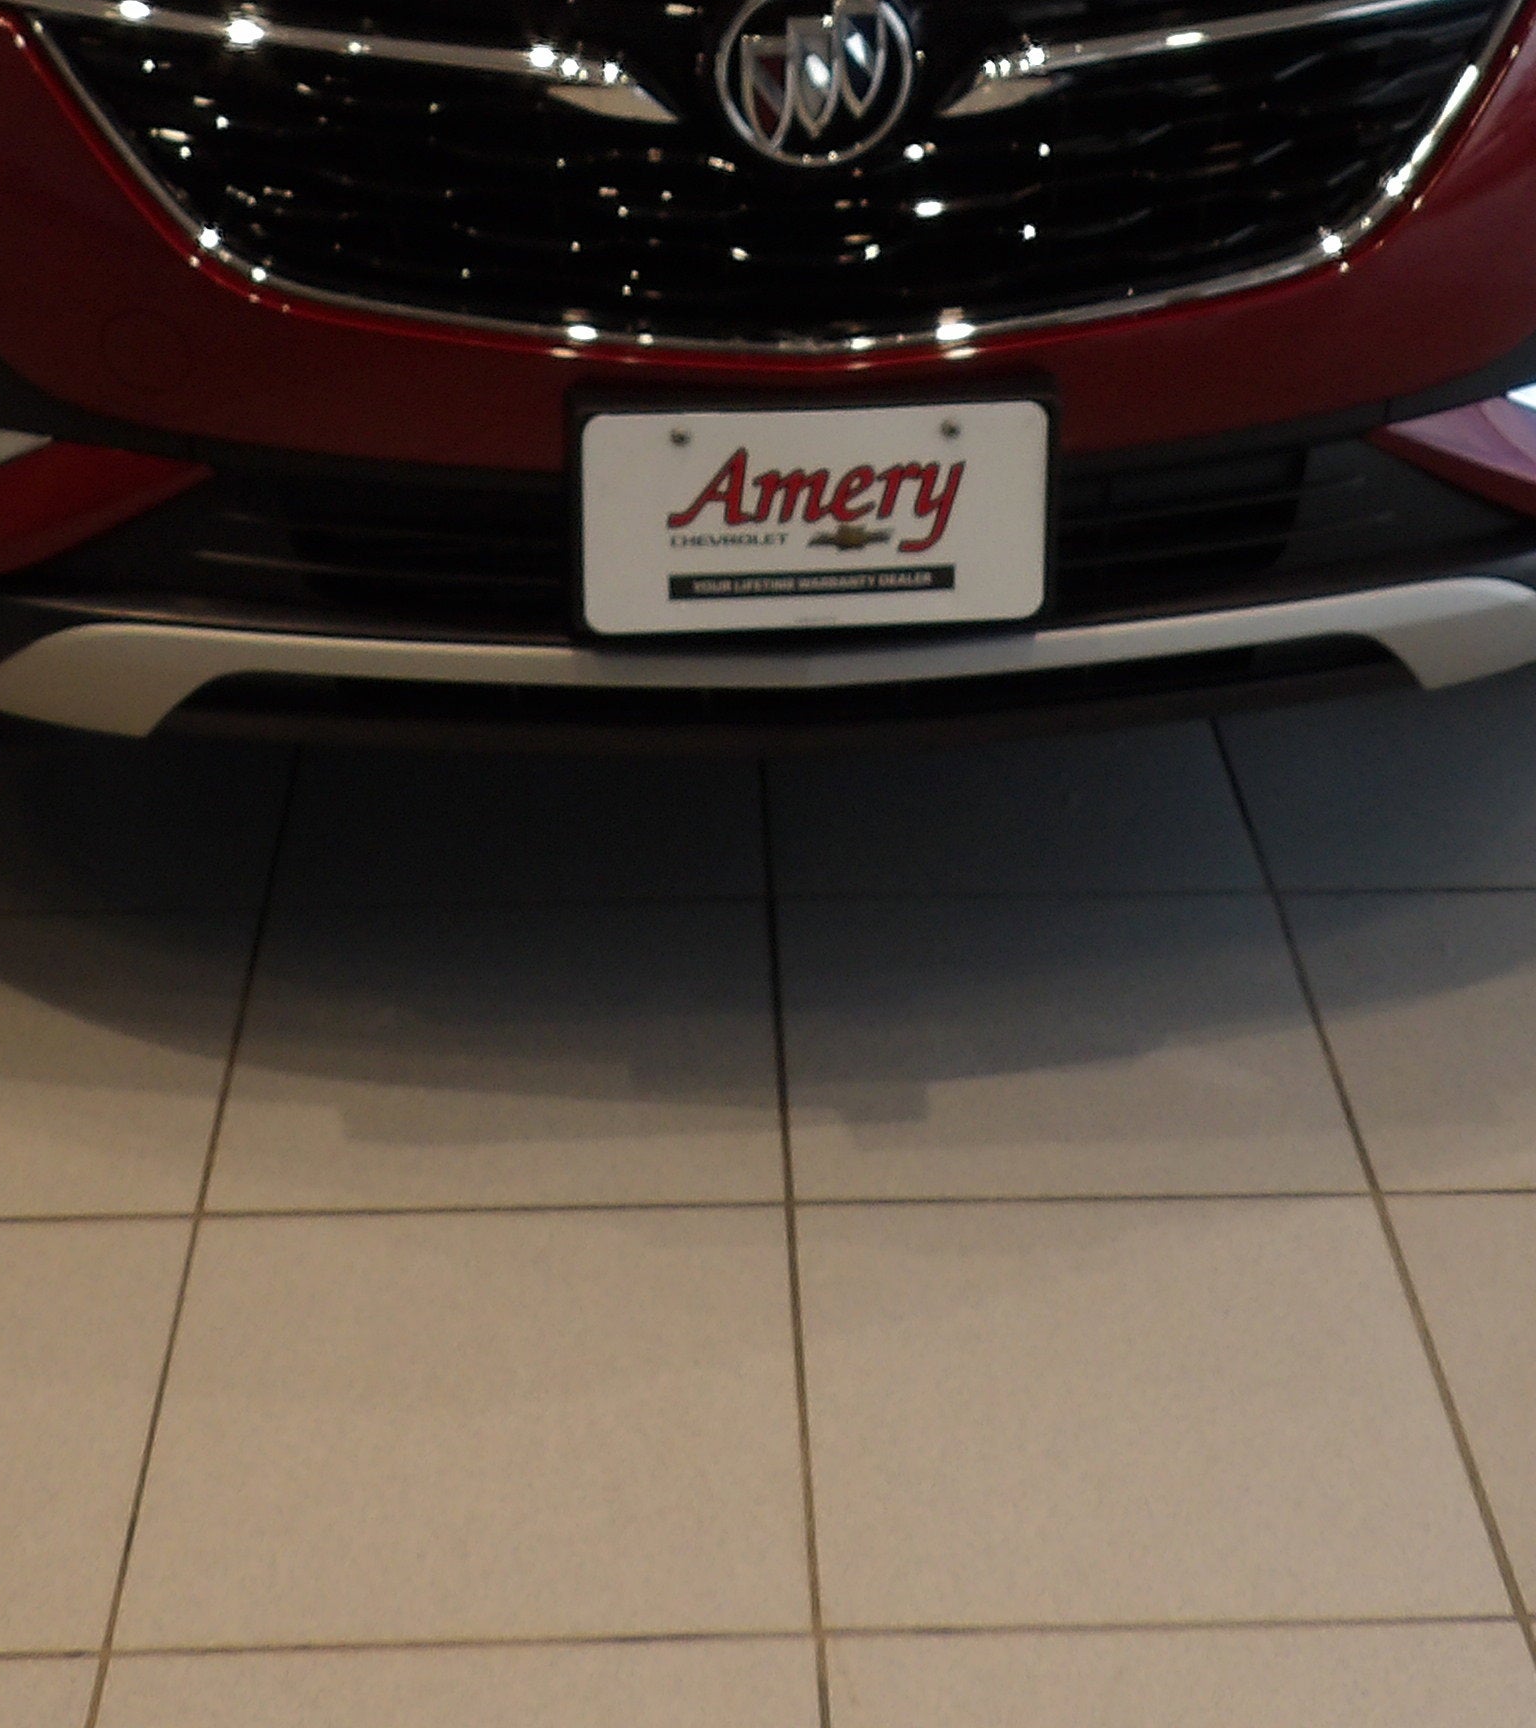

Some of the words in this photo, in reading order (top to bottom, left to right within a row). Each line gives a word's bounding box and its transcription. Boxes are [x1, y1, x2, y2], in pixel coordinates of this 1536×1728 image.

[667, 446, 965, 553] Amery
[669, 533, 788, 548] CHEVROLET
[692, 579, 732, 595] YOUR
[734, 577, 795, 593] LIFETIME
[877, 572, 933, 589] DEALER
